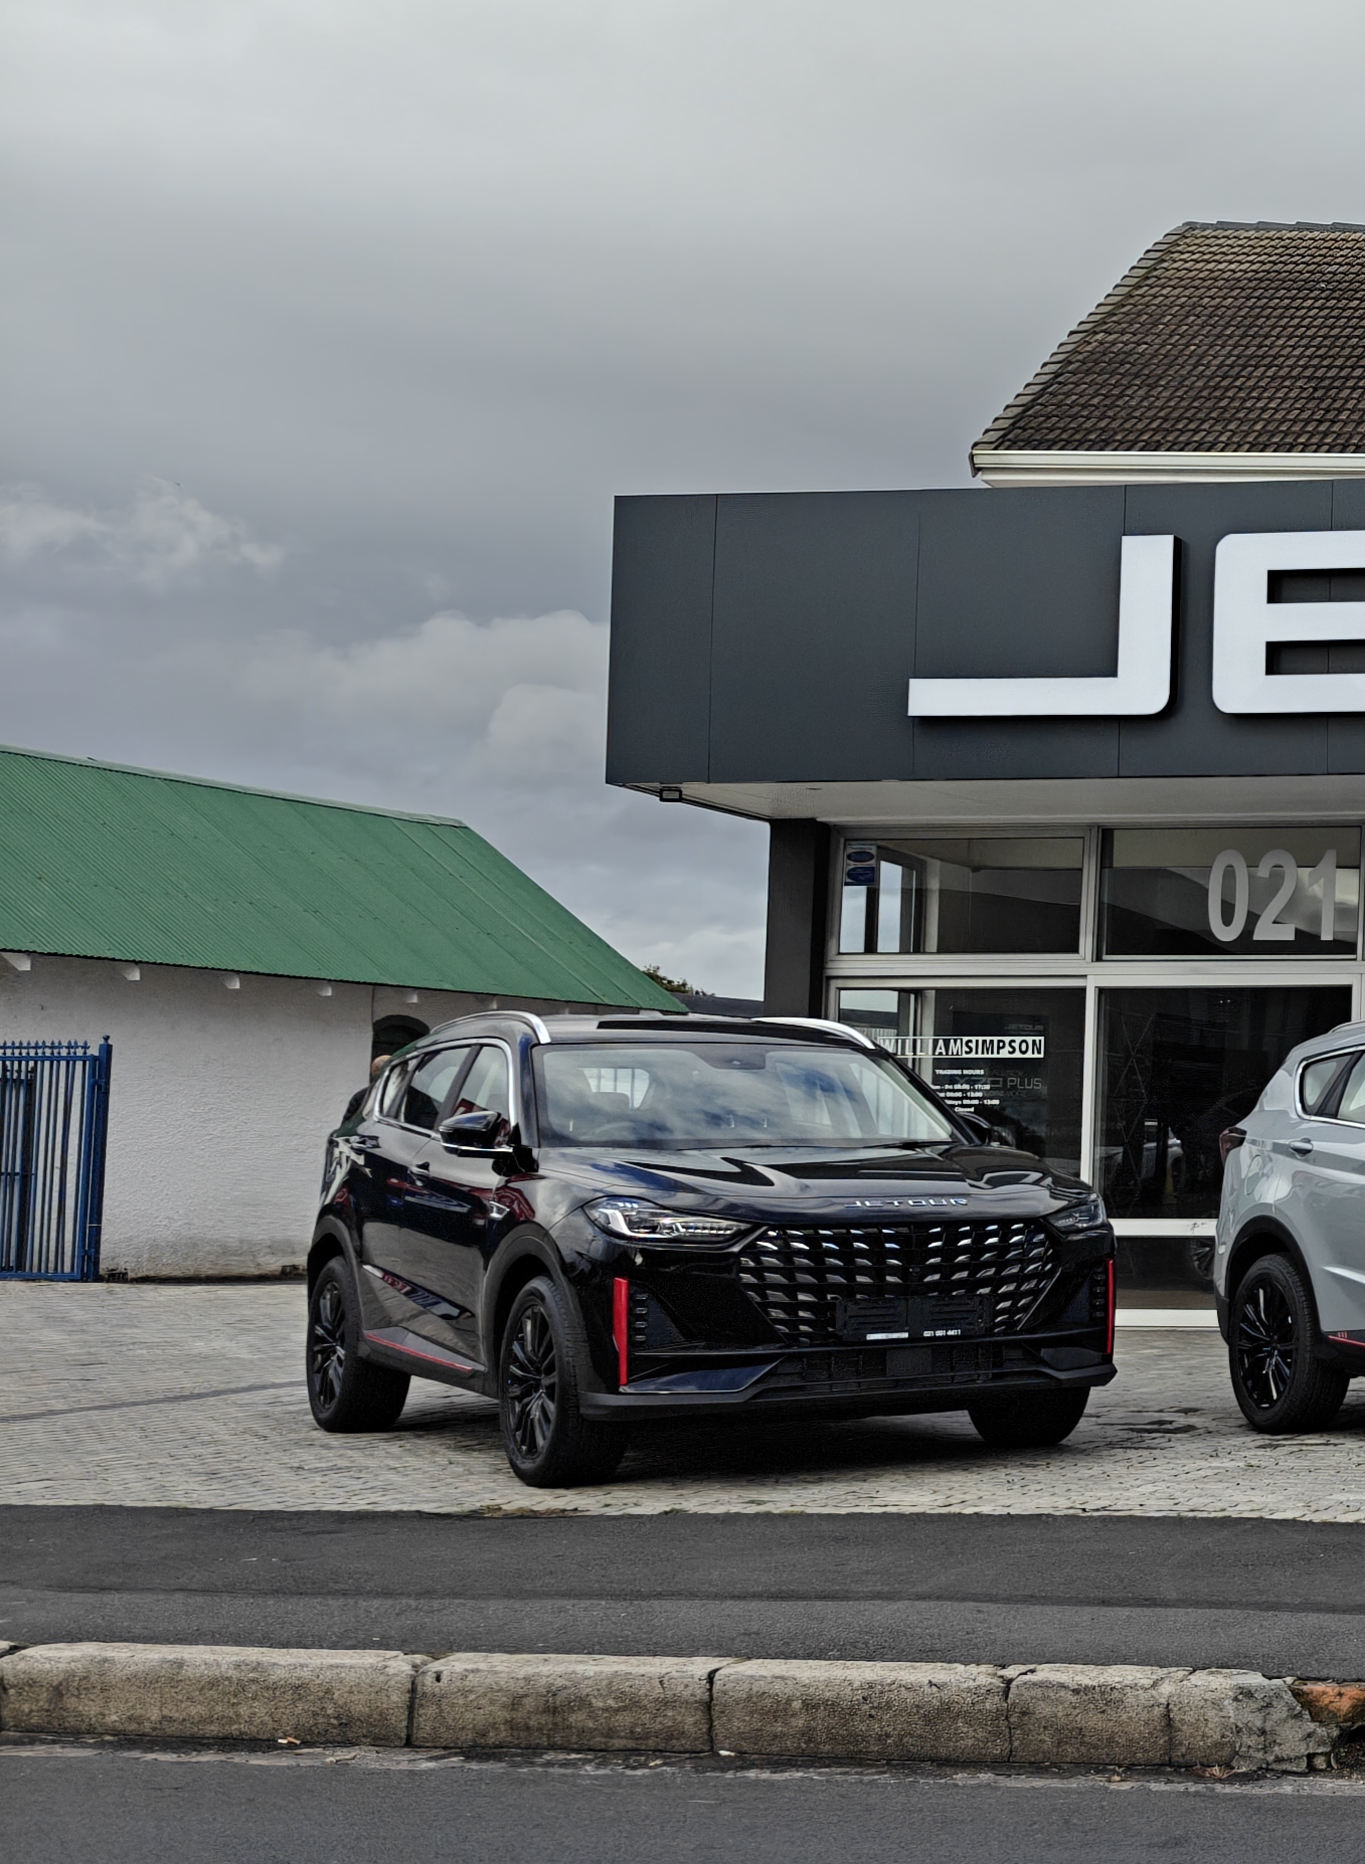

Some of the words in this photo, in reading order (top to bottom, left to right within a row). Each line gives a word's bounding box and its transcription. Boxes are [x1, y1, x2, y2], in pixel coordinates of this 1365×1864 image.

[1208, 849, 1337, 941] 021
[1007, 1077, 1042, 1089] PLUS
[844, 1198, 968, 1209] JETOUR
